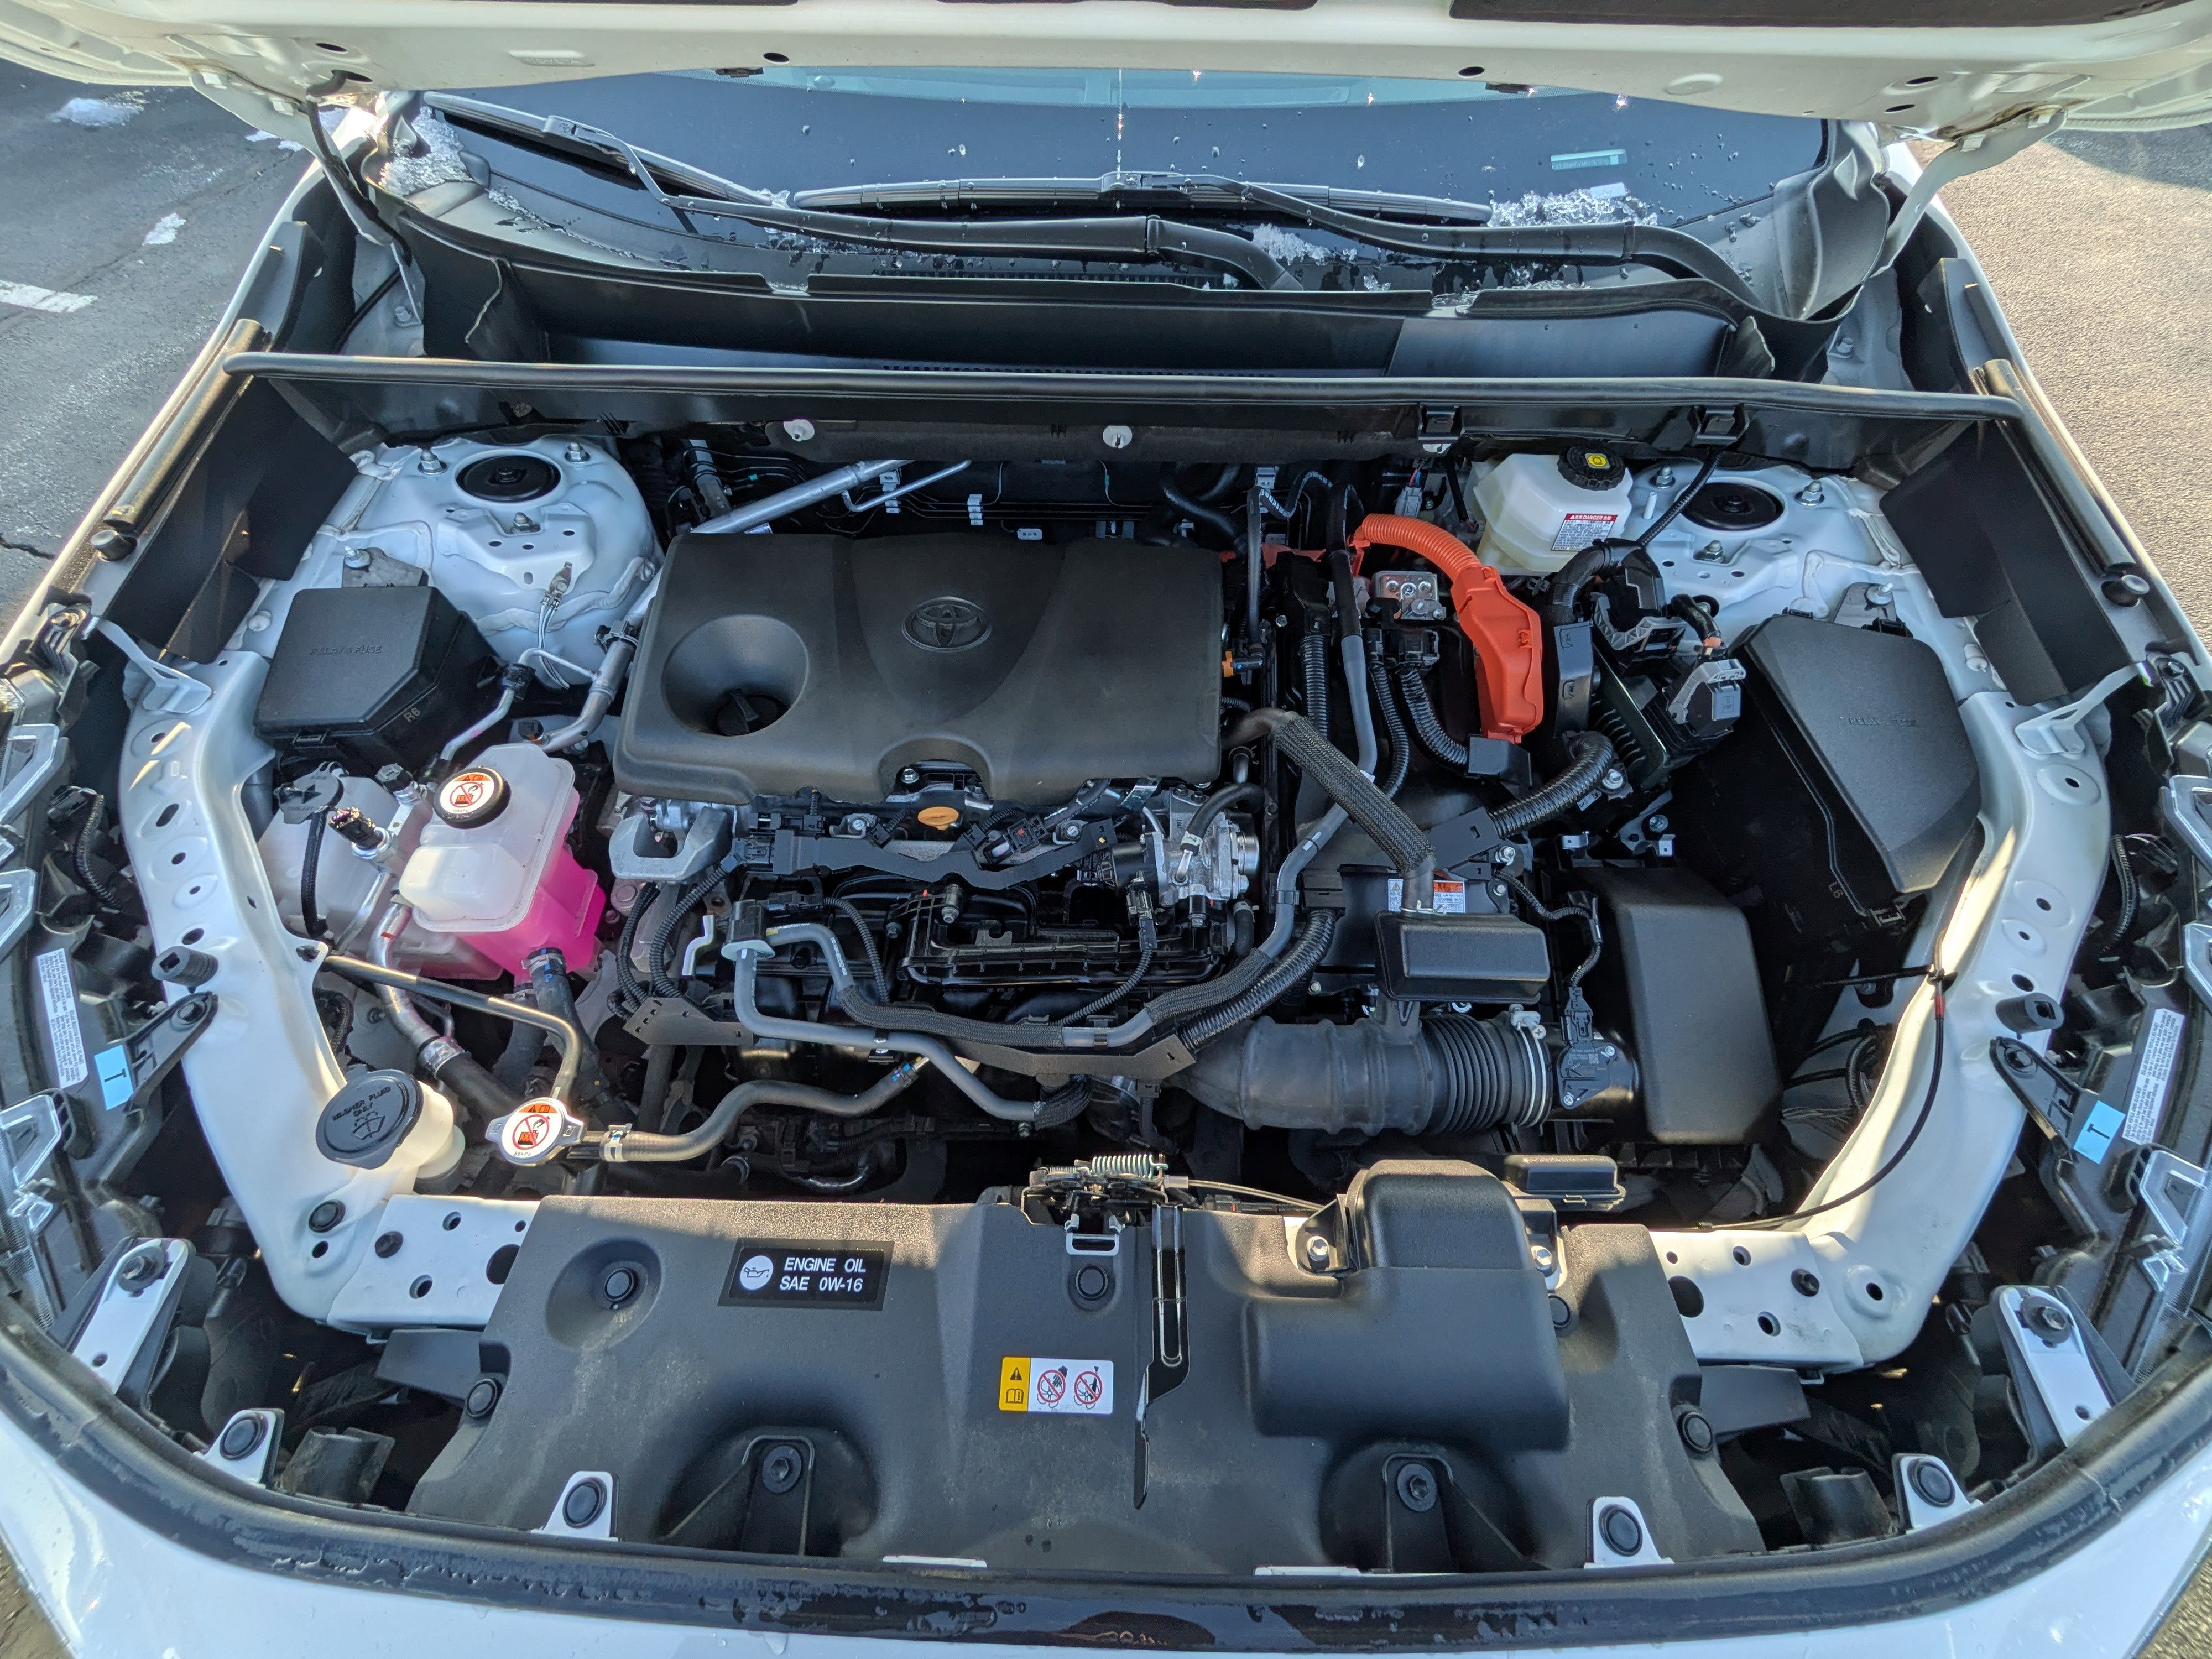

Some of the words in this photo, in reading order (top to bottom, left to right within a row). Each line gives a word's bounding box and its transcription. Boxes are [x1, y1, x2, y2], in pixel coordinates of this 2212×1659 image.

[354, 645, 383, 654] FUSE
[403, 707, 421, 722] R6
[2086, 1123, 2110, 1140] T
[784, 1256, 837, 1272] ENGINE
[844, 1258, 867, 1273] OIL
[779, 1275, 810, 1291] SAE
[819, 1276, 863, 1292] 0W-16
